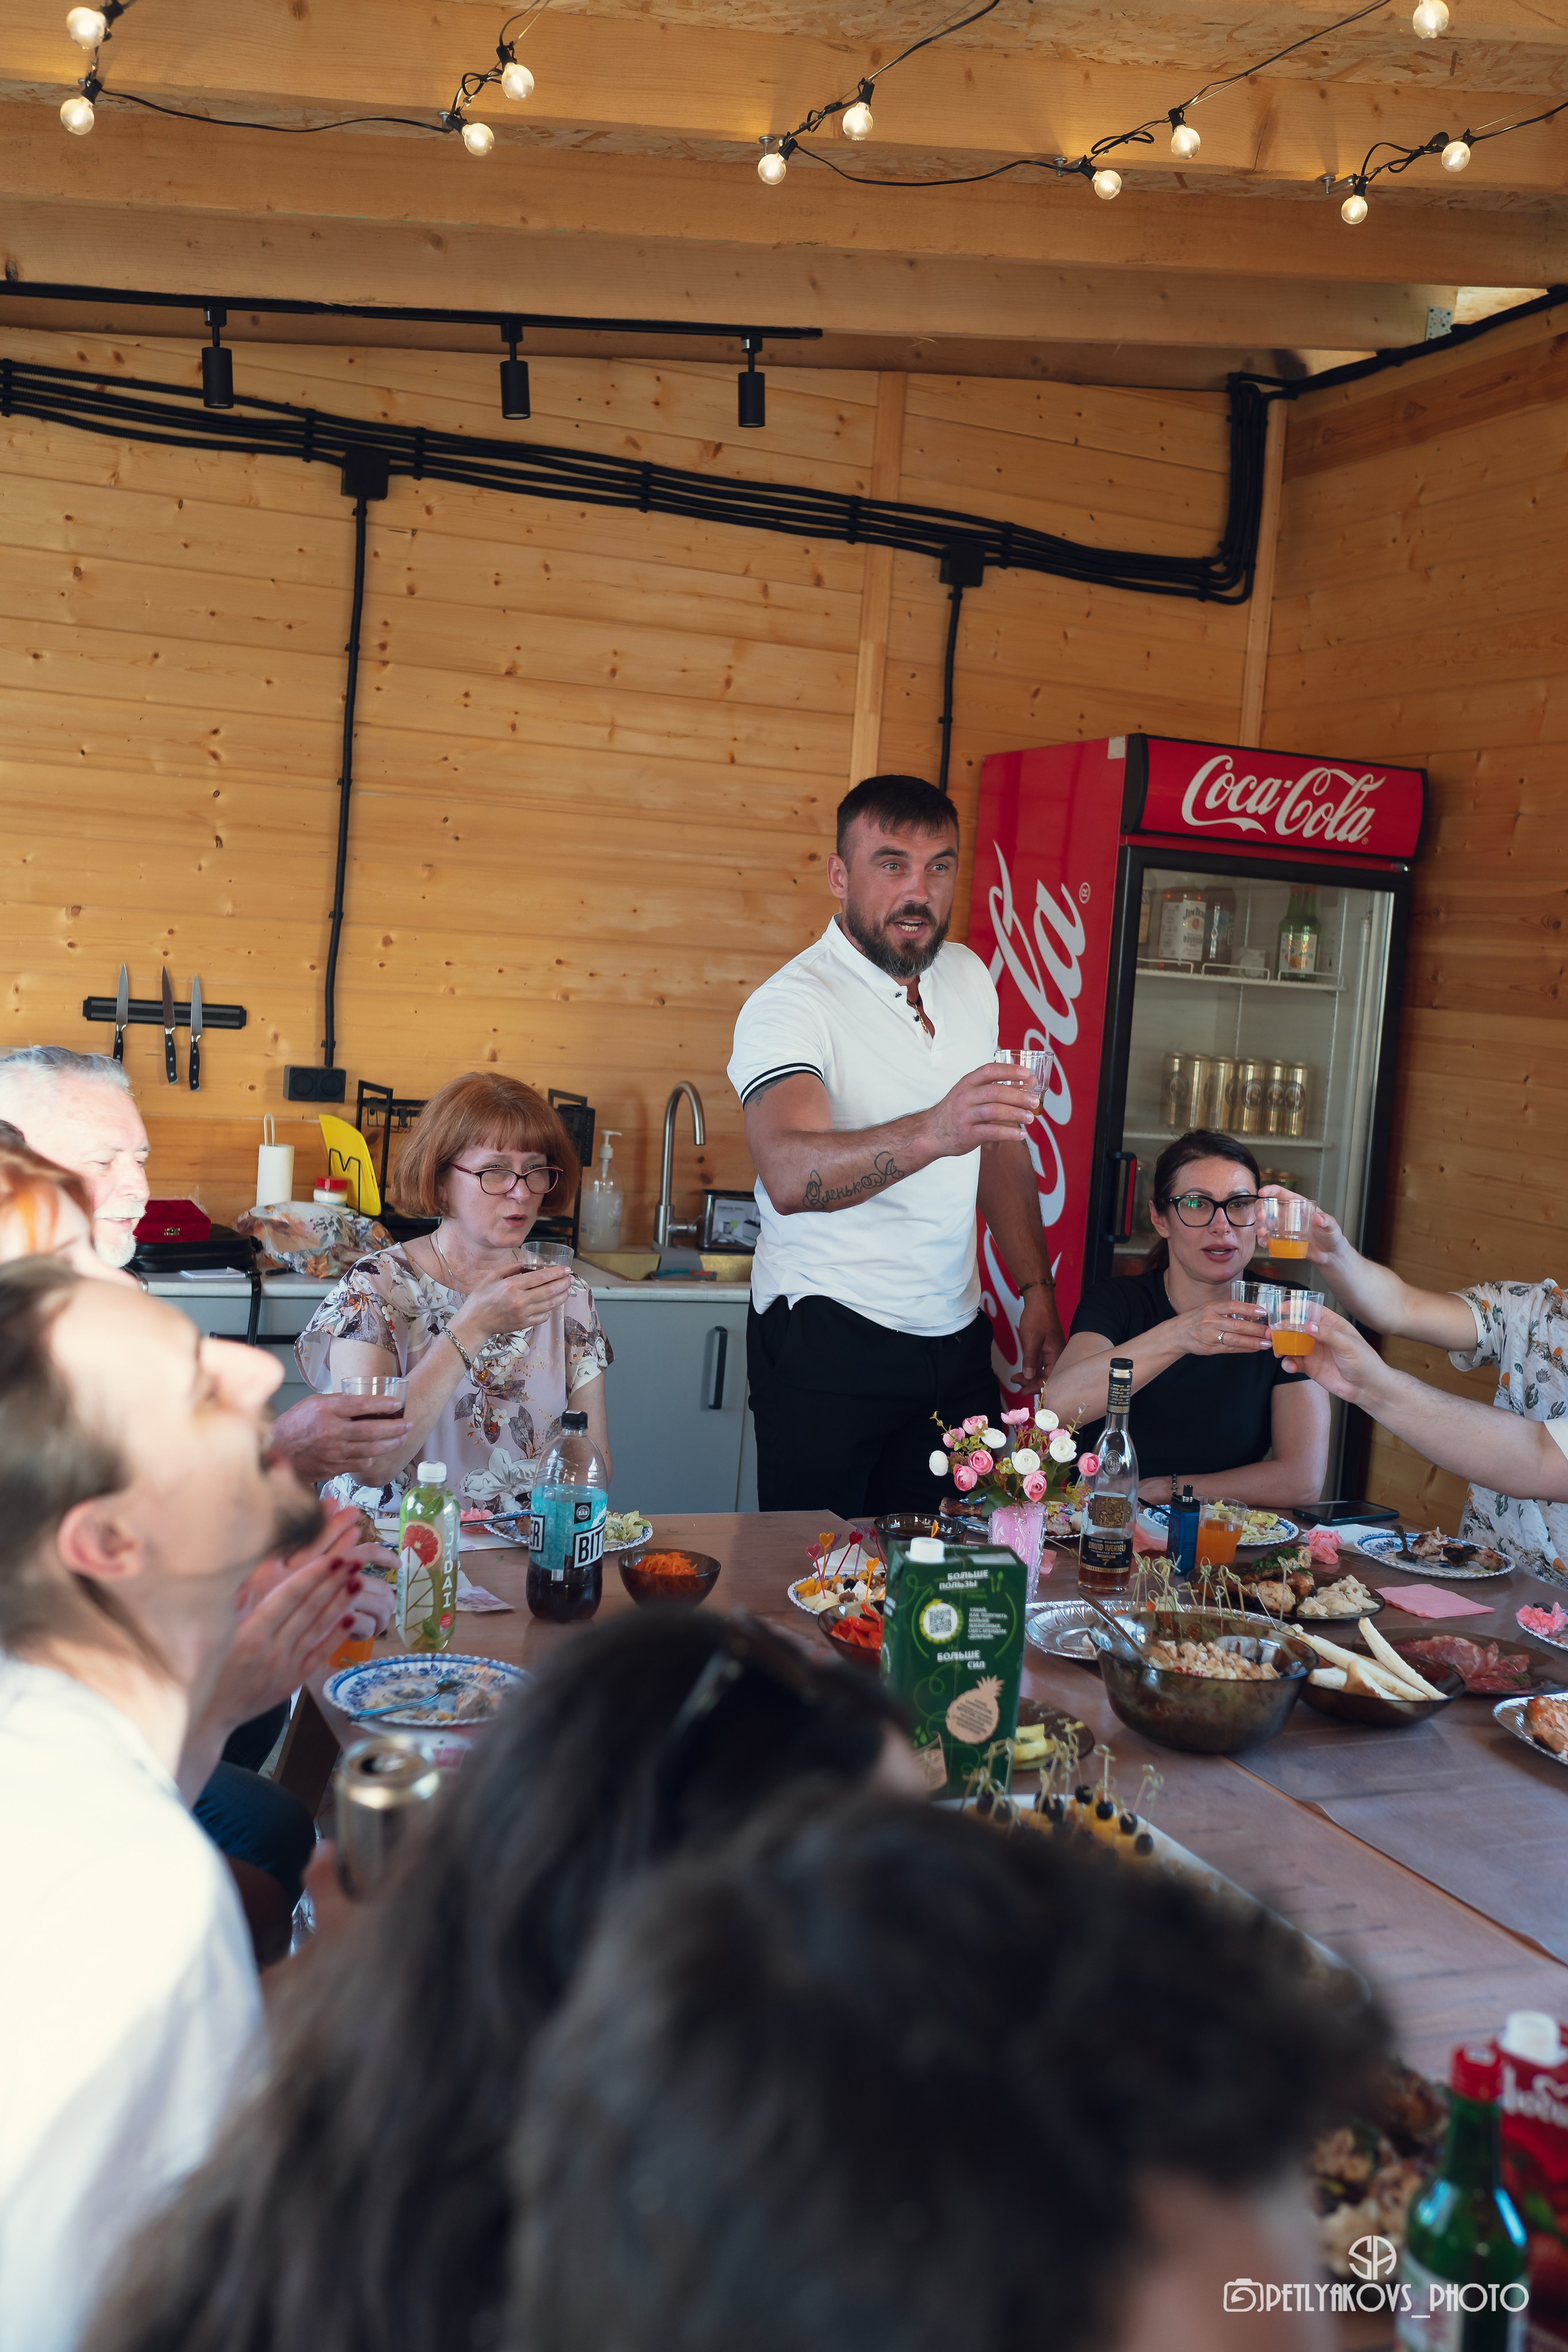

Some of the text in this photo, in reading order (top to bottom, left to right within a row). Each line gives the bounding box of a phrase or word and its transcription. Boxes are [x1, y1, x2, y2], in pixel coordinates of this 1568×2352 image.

[1182, 754, 1386, 843] Coca-Cola
[578, 1527, 605, 1564] BIT
[1088, 1541, 1103, 1551] DAVID
[947, 1569, 989, 1581] БОЛЬШЕ
[939, 1580, 977, 1591] ПОЛЬЗЫ
[937, 1649, 980, 1661] БОЛЬШЕ
